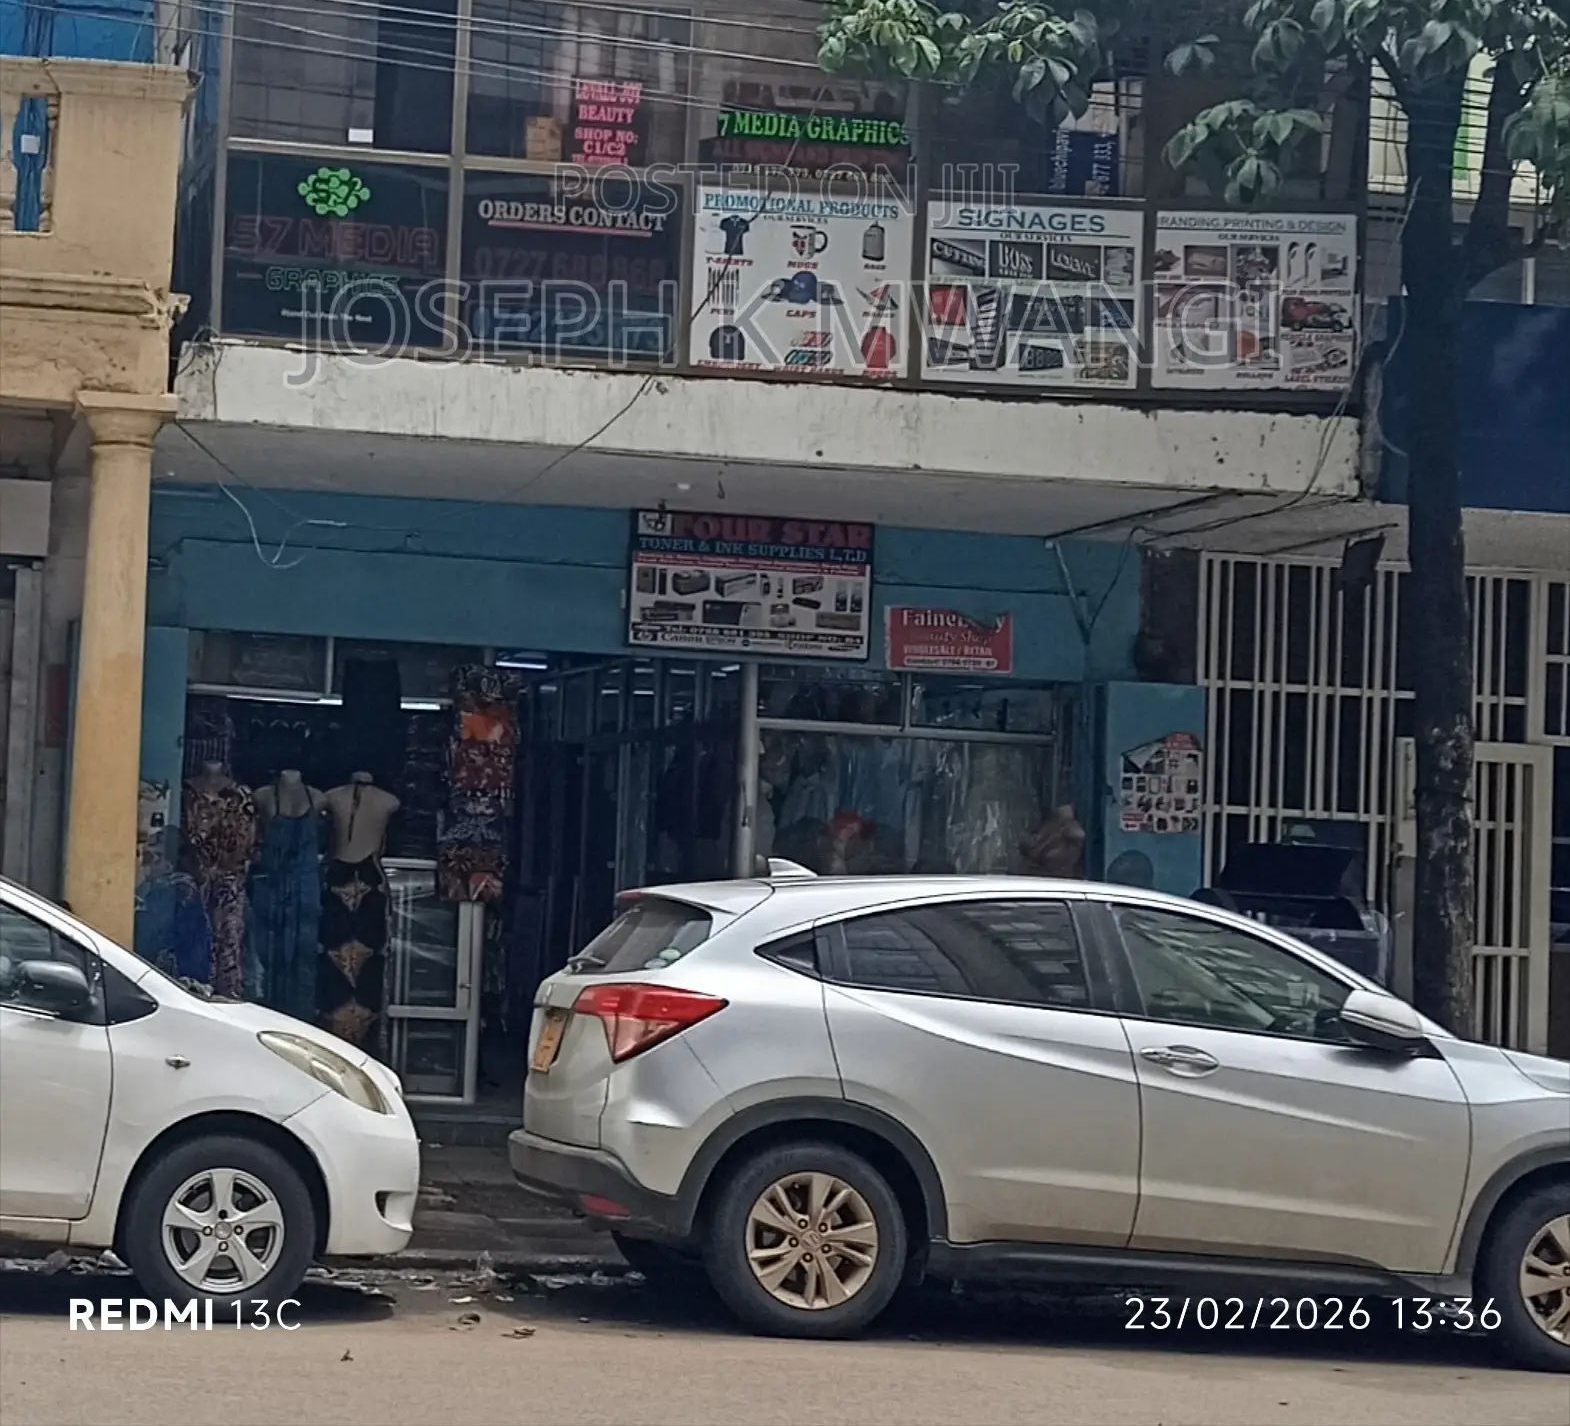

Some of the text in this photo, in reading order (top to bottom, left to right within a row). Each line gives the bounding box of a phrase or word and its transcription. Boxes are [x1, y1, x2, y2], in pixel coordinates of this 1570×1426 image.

[578, 105, 635, 124] BEAUTY
[575, 127, 613, 143] SHOP
[719, 111, 910, 145] 7 MEDIA GRAPHICS
[478, 199, 668, 231] ORDERS CONTACT
[703, 192, 899, 220] PROMOTIONAL PRODUCTS
[957, 208, 1106, 233] SIGNAGES
[1223, 217, 1285, 230] PRINTING
[1298, 220, 1347, 232] DESIGN
[300, 217, 440, 265] MEDIA
[785, 309, 817, 319] CAPS
[671, 511, 872, 549] FOUR STAR
[638, 536, 695, 552] TONER
[698, 539, 711, 553] &
[715, 540, 745, 555] INK
[748, 542, 826, 560] SUPPLIES
